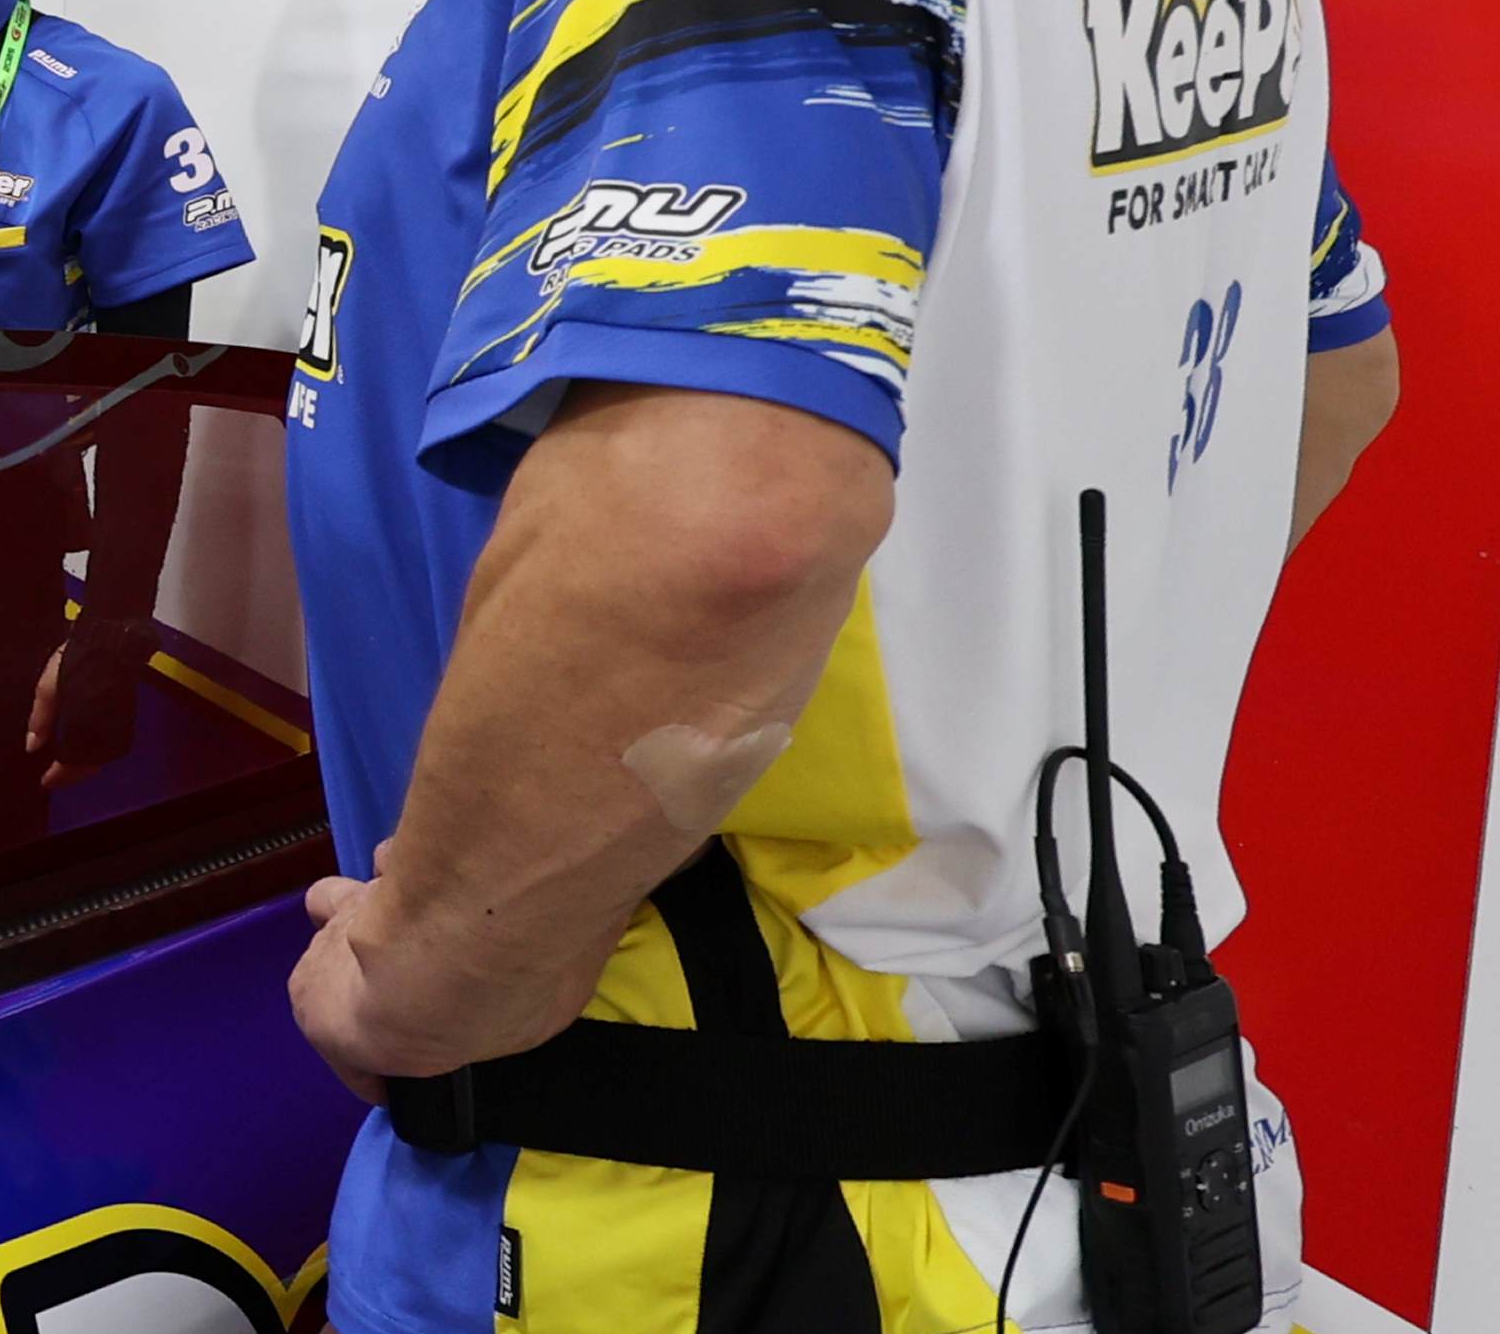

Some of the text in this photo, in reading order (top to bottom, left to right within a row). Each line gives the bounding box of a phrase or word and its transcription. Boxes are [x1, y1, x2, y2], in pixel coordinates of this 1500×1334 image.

[163, 126, 216, 194] 3
[1107, 181, 1165, 235] FOR
[600, 240, 700, 262] PADS
